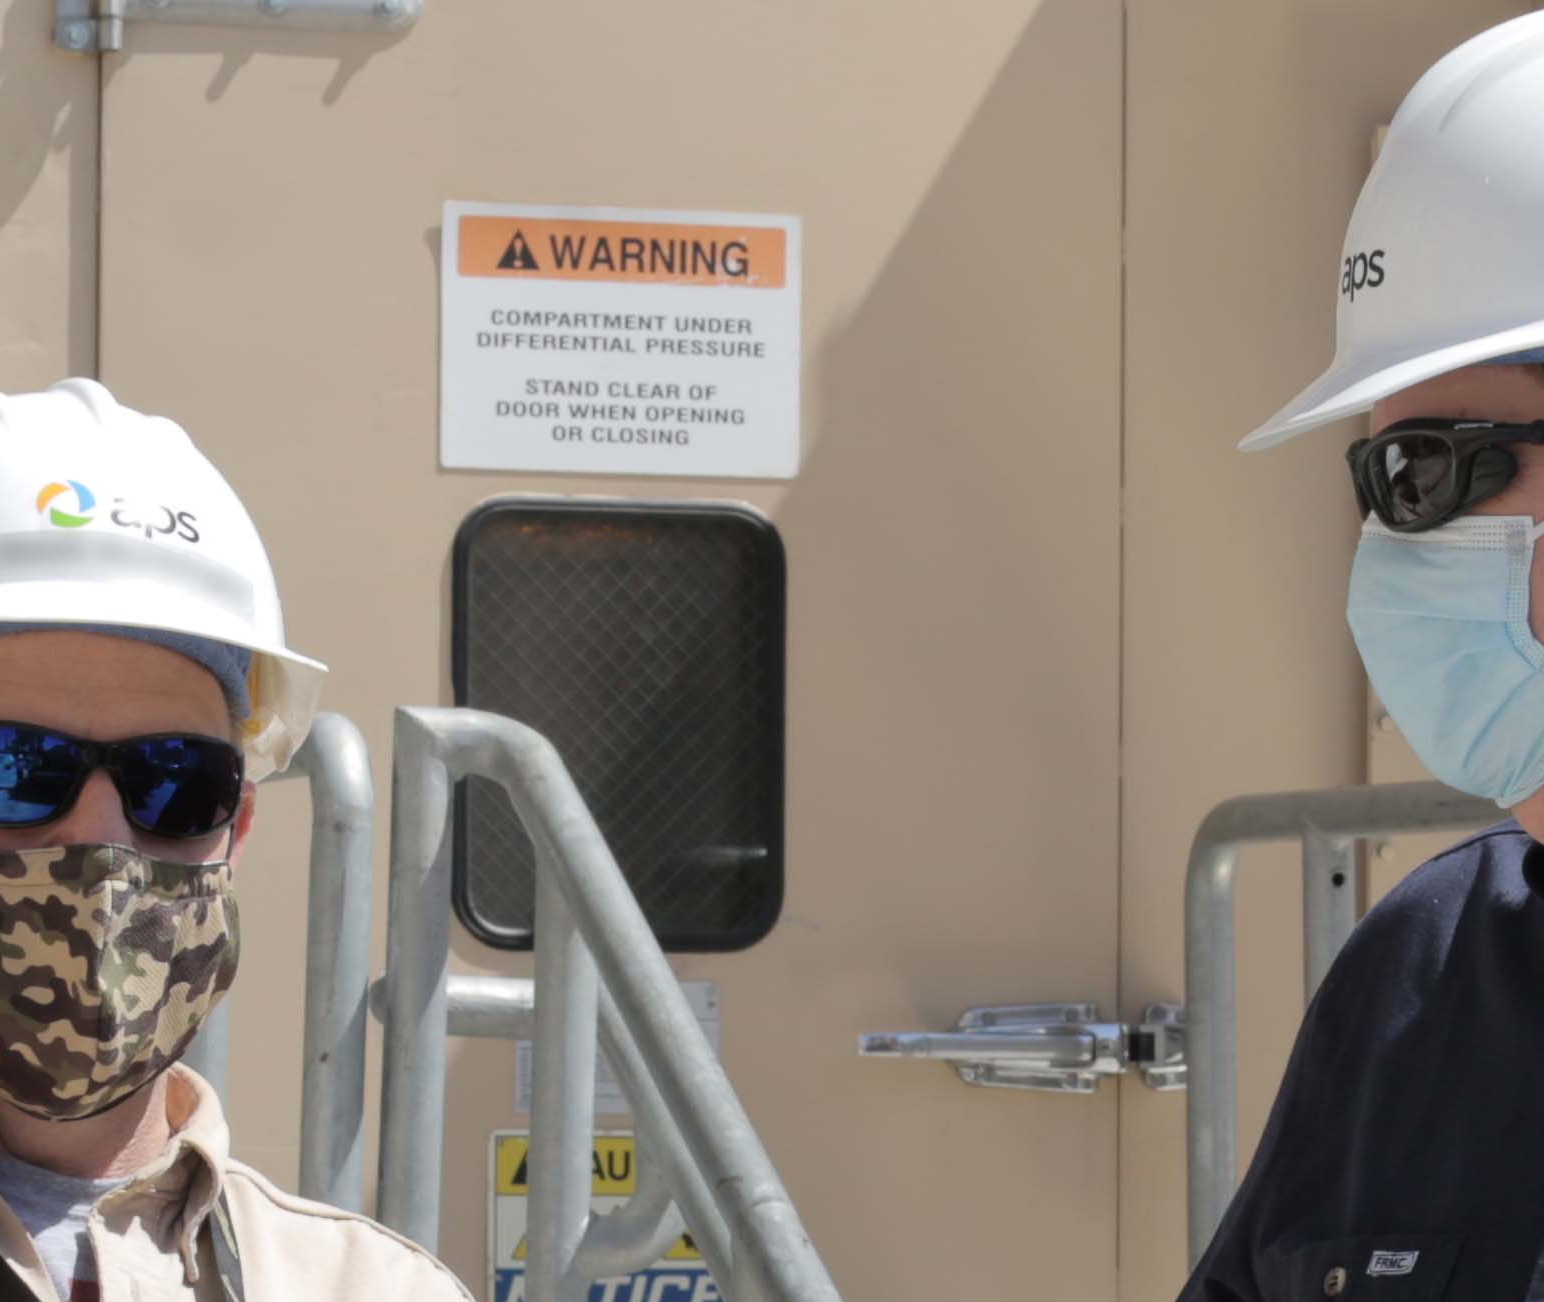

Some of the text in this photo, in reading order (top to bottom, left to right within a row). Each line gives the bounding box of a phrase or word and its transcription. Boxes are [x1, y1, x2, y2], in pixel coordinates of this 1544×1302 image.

[549, 233, 750, 277] WARNING
[1341, 248, 1385, 303] aps
[490, 309, 753, 335] COMPARTMENT UNDER
[476, 331, 766, 359] DIFFERENTIAL PRESSURE
[524, 378, 717, 402] STAND CLEAR OF
[495, 400, 746, 426] DOOR WHEN OPENING
[551, 425, 690, 447] OR CLOSING
